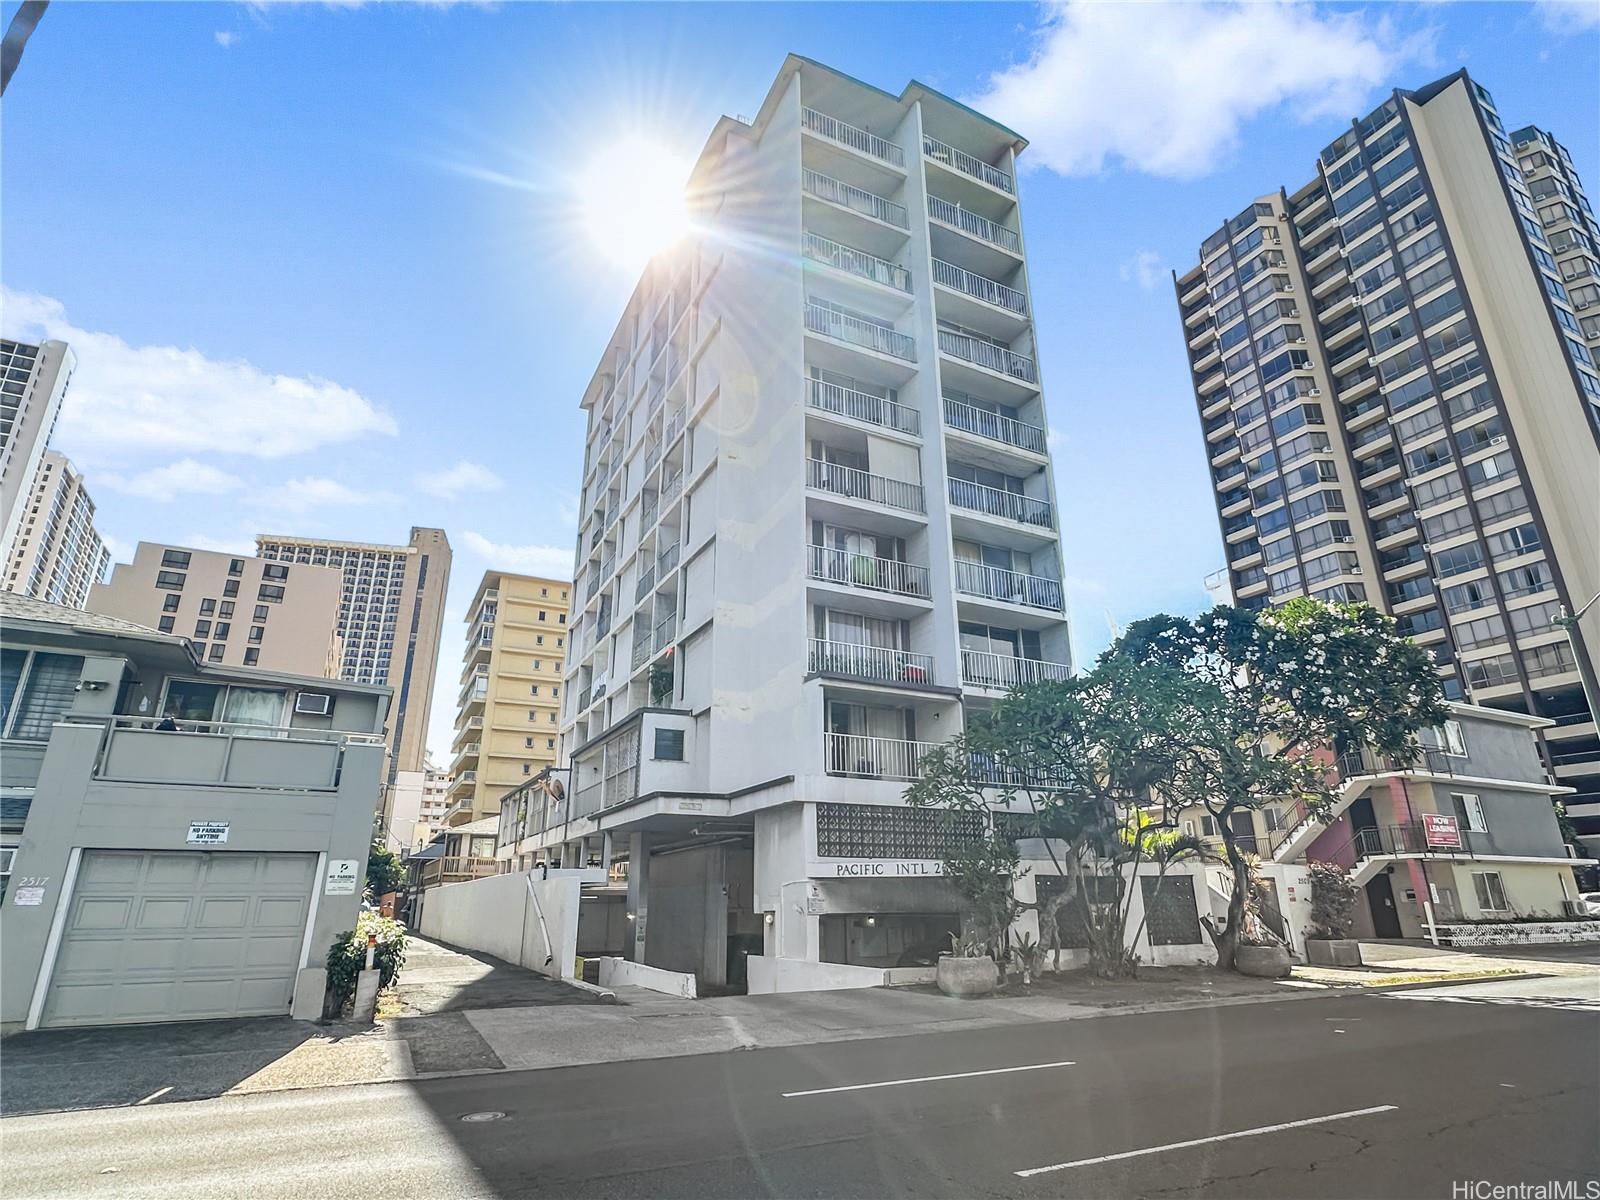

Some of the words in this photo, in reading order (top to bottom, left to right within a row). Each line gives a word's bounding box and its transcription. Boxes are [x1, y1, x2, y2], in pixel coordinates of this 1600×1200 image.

[1429, 824, 1456, 833] LEASING
[836, 863, 884, 876] PACIFIC
[896, 863, 928, 875] INTL
[19, 876, 50, 887] 2517
